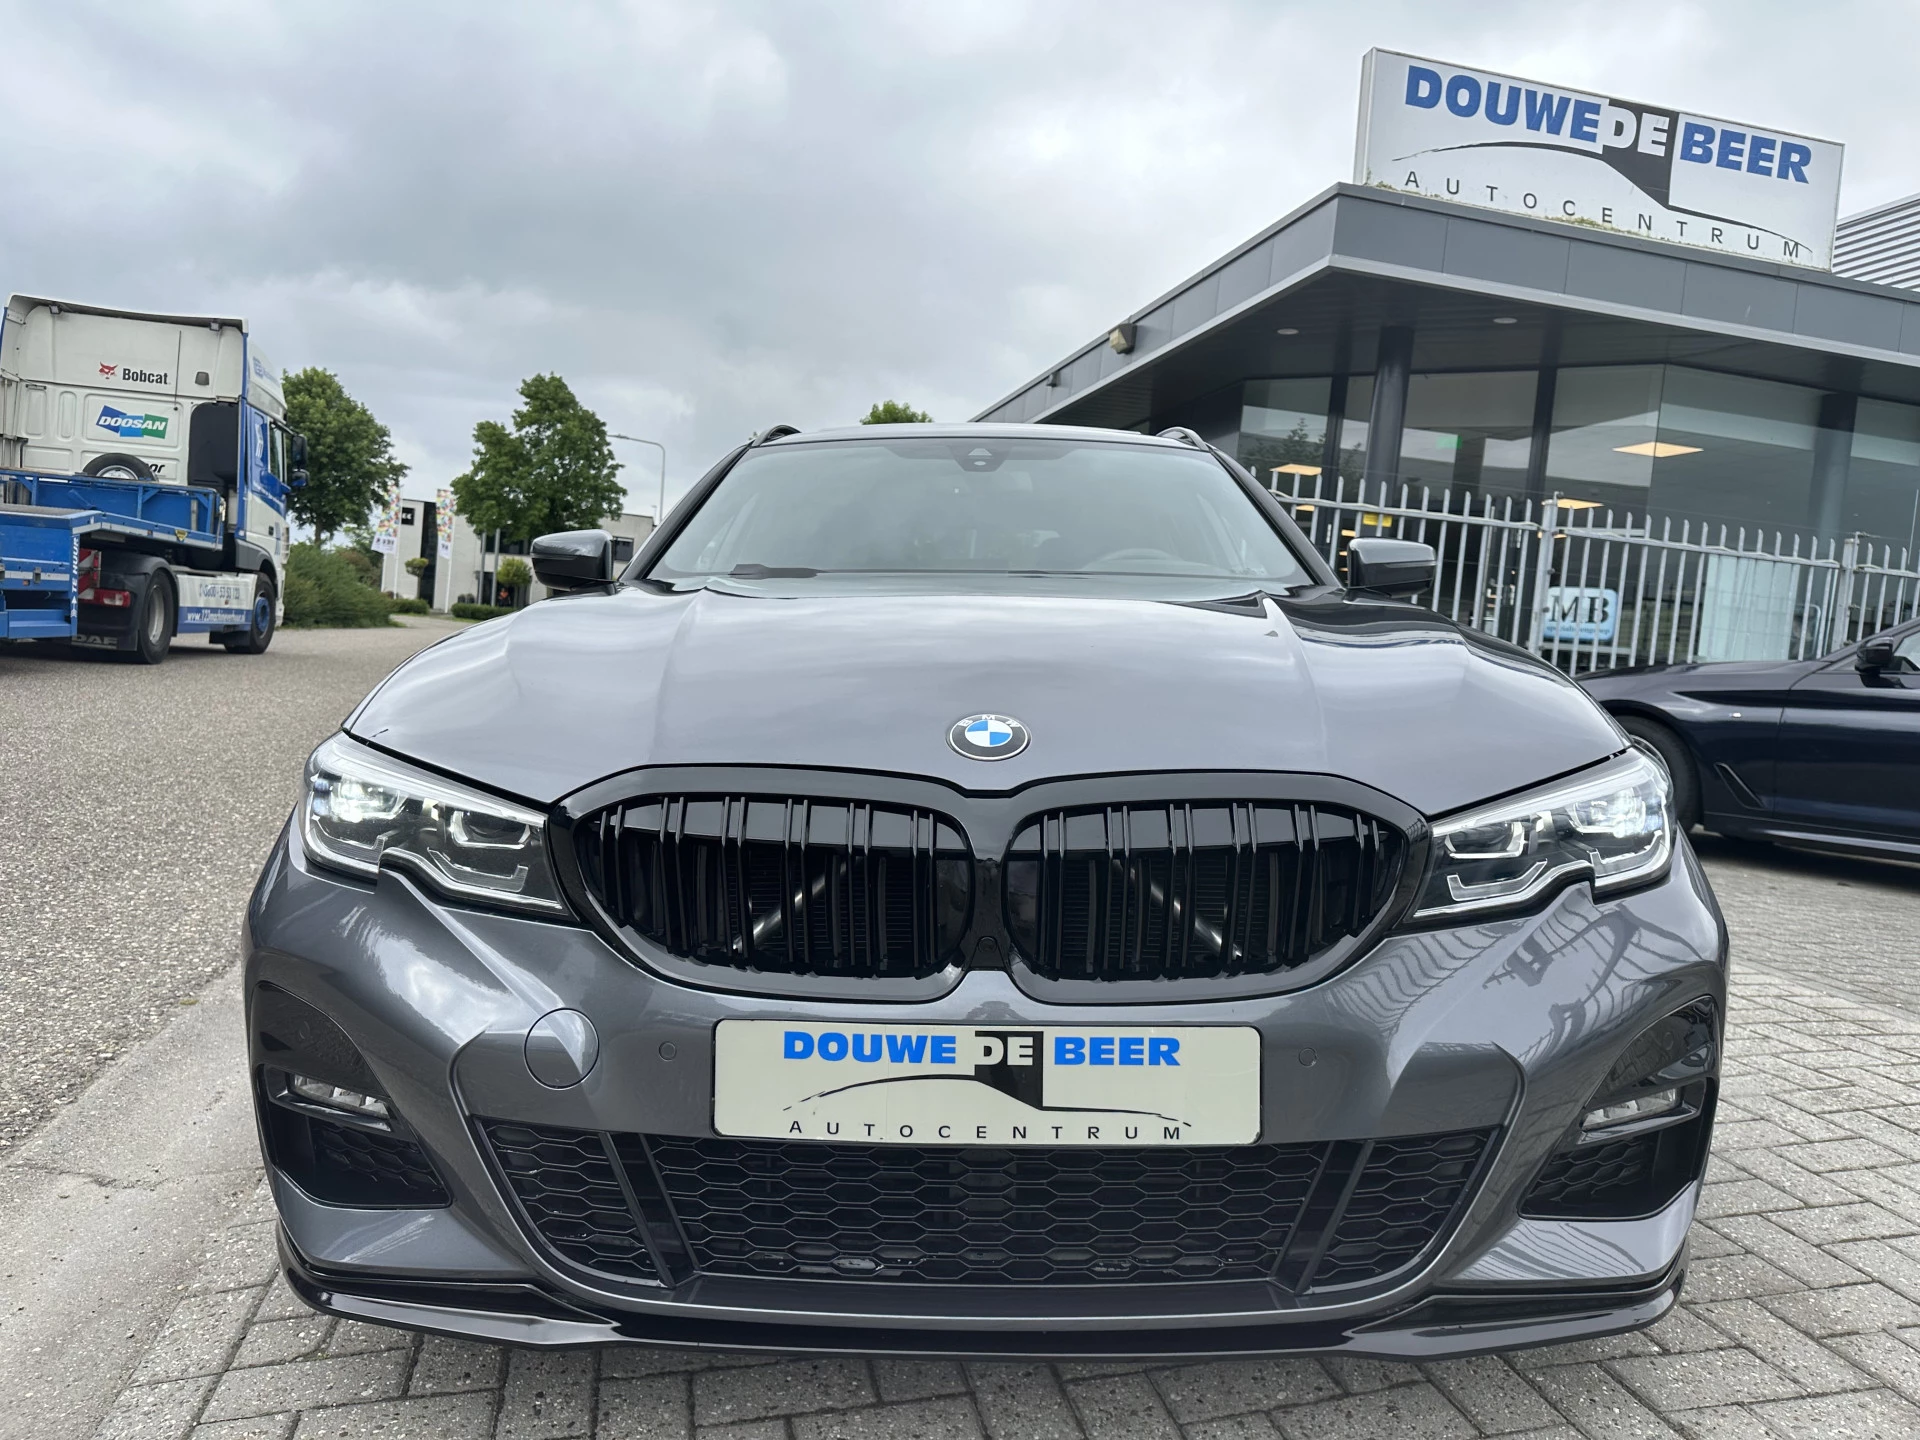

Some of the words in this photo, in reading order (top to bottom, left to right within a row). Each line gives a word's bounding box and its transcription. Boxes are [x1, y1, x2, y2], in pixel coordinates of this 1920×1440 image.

[1405, 65, 1601, 143] DOUWE
[1602, 108, 1670, 157] DE
[1680, 122, 1812, 184] BEER
[1405, 171, 1800, 258] AUTOCENTRUM
[122, 368, 168, 385] Bobcat
[99, 416, 166, 431] DOOSAN
[72, 537, 80, 575] HUUR
[72, 578, 78, 593] TE
[1549, 595, 1609, 624] MB
[72, 633, 118, 646] DAF
[783, 1030, 957, 1064] DOUWE
[975, 1036, 1034, 1066] DE
[1054, 1037, 1181, 1067] BEER
[789, 1120, 1181, 1140] AUTOCENTRUM
